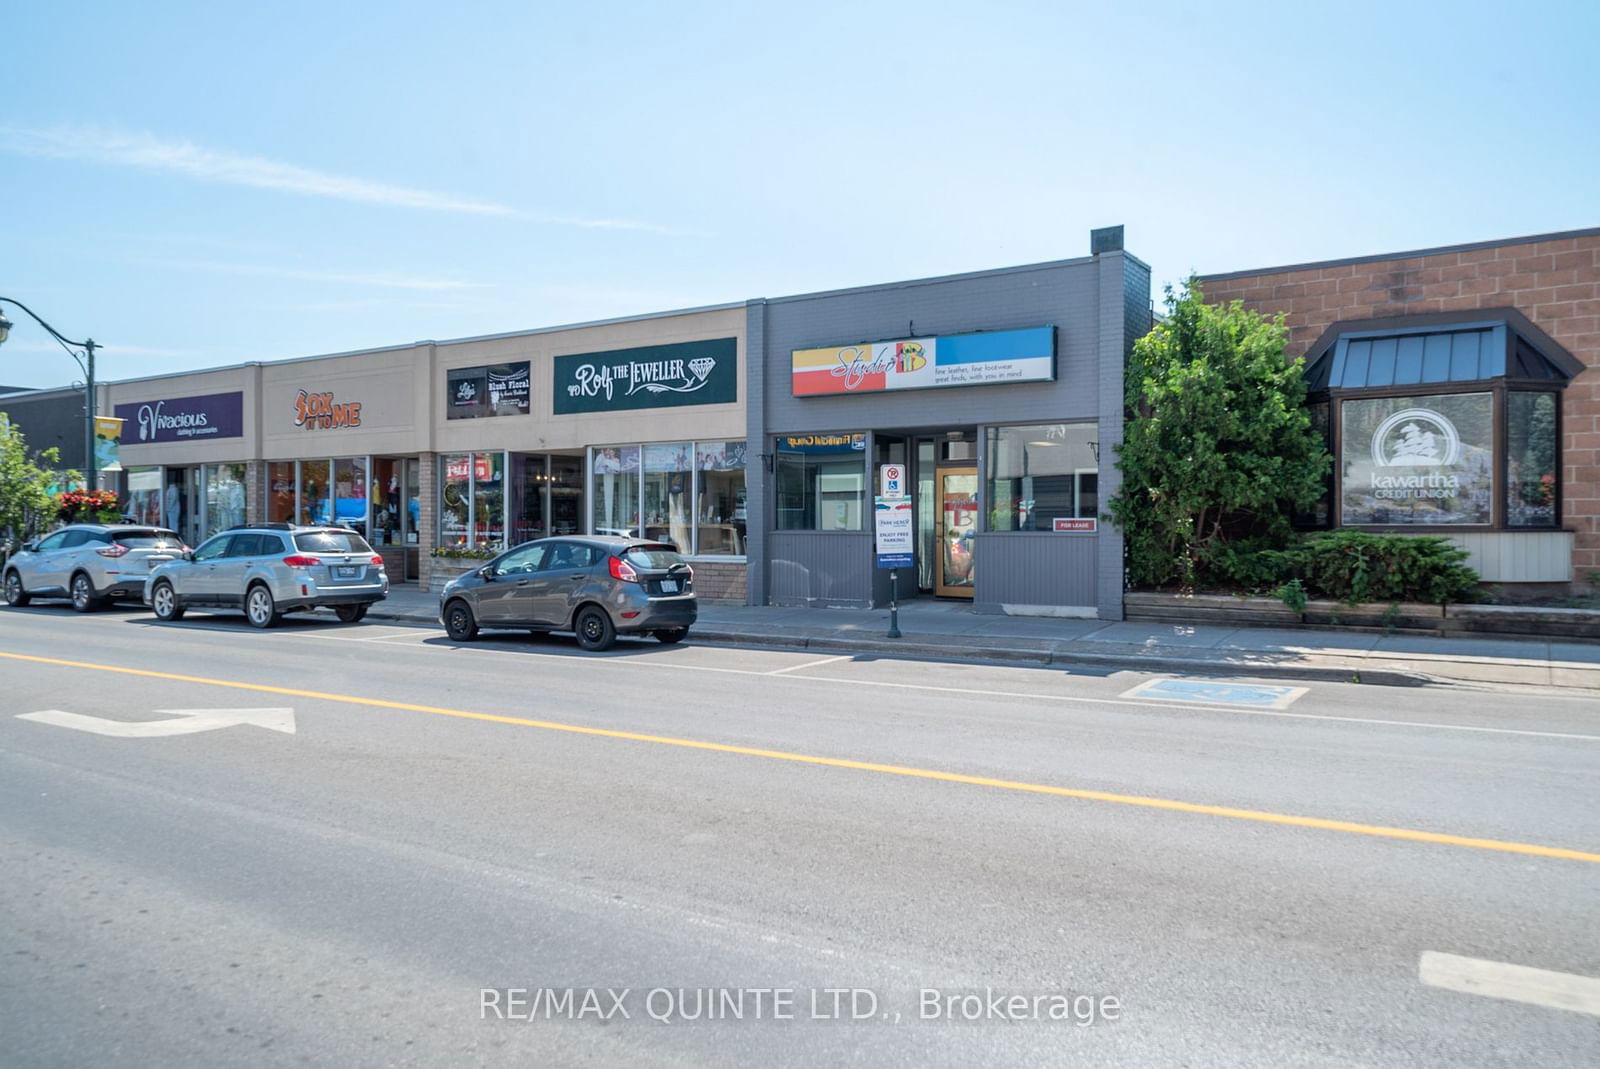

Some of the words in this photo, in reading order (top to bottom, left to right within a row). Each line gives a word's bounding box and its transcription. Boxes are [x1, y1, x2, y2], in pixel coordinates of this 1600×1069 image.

[831, 346, 896, 390] Studio
[935, 367, 946, 375] fine
[948, 365, 969, 375] leather,
[971, 364, 983, 372] fine
[985, 363, 1012, 371] footwear
[1007, 369, 1023, 377] mind
[488, 382, 507, 391] Blush
[508, 378, 530, 389] Floral
[575, 364, 614, 400] Rolf
[613, 365, 629, 379] THE
[625, 359, 685, 395] JEWELLER
[138, 401, 207, 440] Vivacious
[319, 416, 332, 429] TO
[332, 402, 361, 428] ME
[1371, 472, 1459, 488] kawartha
[1374, 489, 1413, 499] CREDIT
[1413, 489, 1456, 499] UNION
